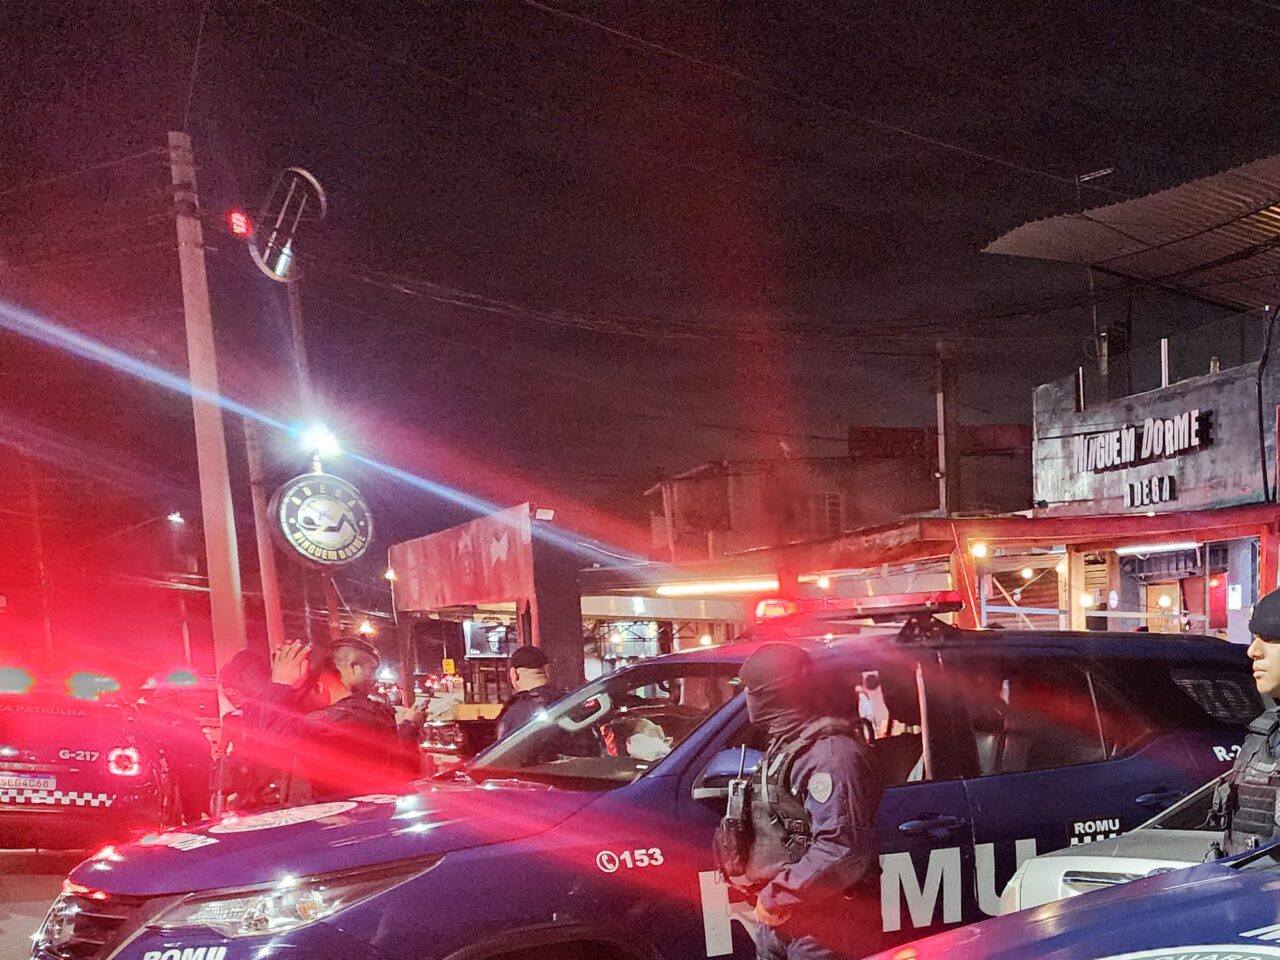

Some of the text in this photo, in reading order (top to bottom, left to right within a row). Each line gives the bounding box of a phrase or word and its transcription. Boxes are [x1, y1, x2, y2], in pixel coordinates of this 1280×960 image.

[1141, 408, 1201, 460] DORME
[1123, 475, 1171, 508] ADEGA
[58, 749, 99, 762] G-217
[1073, 818, 1120, 834] ROMU
[620, 847, 664, 869] 153
